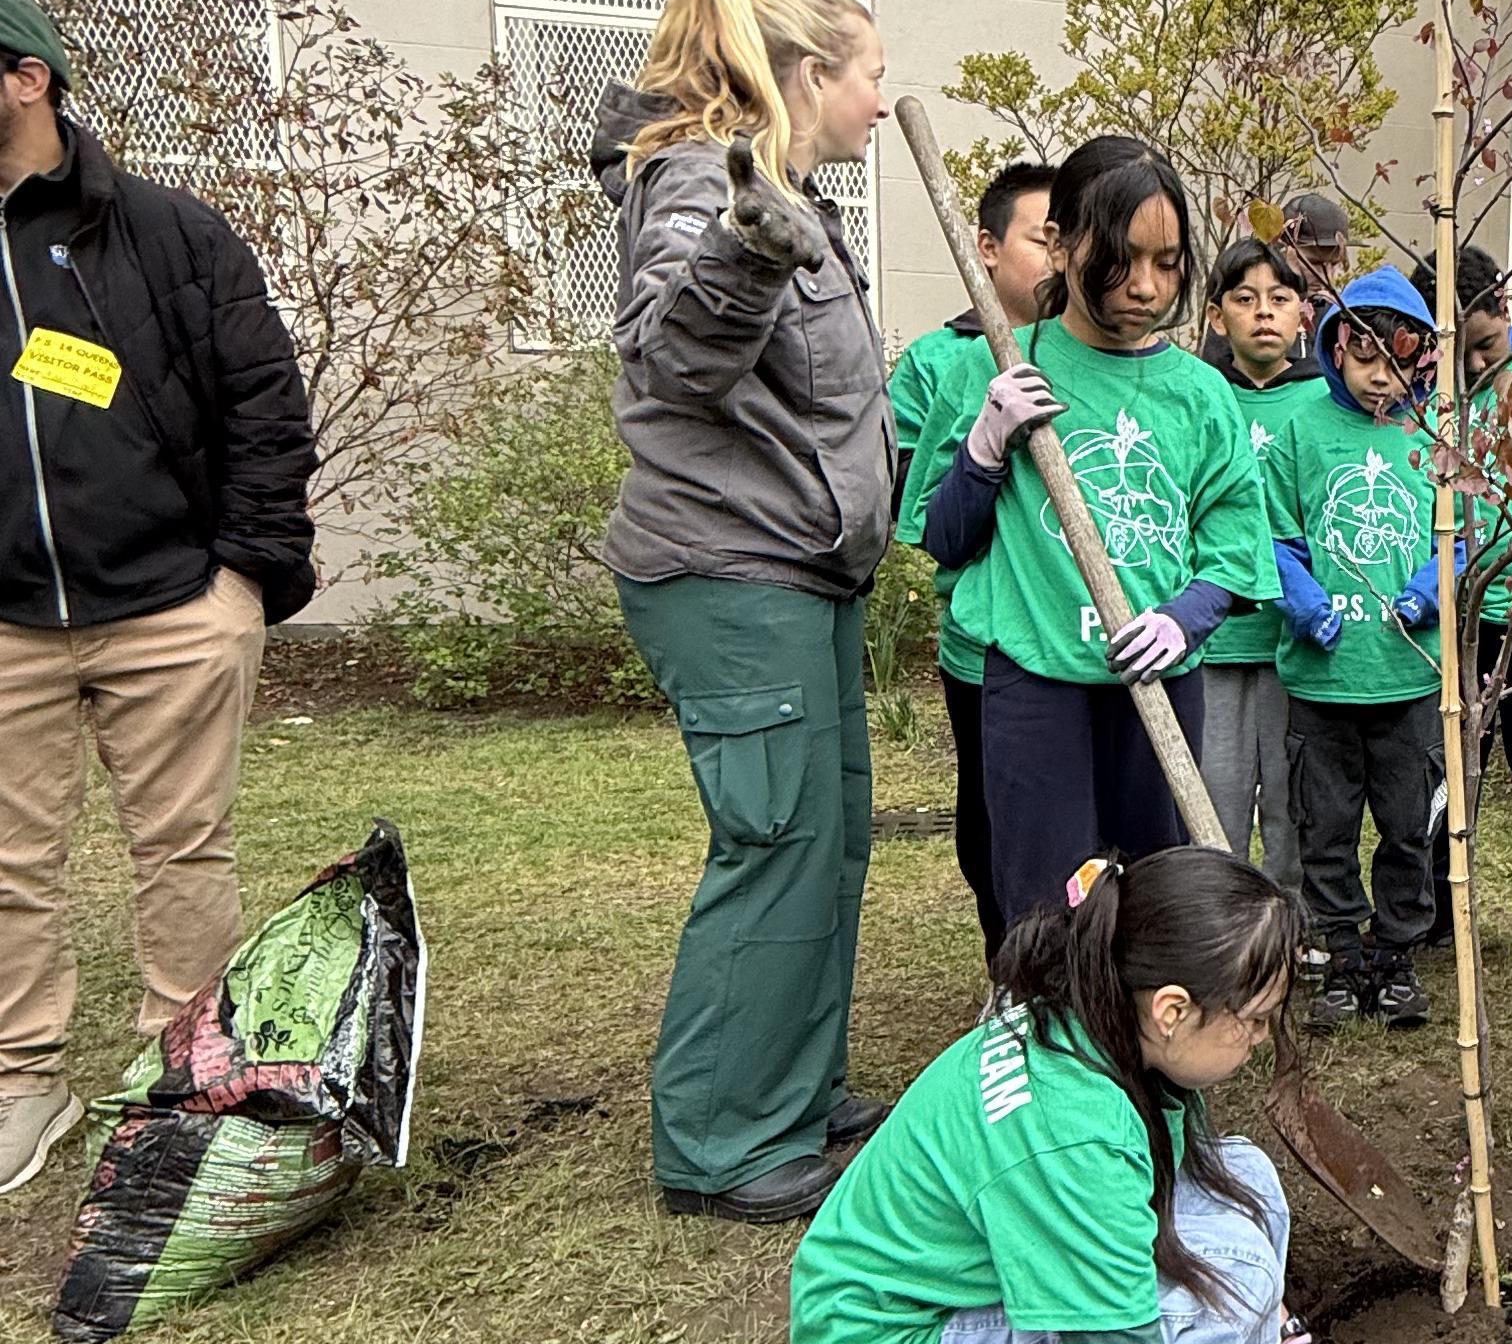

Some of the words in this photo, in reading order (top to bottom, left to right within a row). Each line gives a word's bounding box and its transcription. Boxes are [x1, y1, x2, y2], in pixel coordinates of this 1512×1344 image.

[28, 350, 80, 373] VISITOR
[83, 366, 113, 384] PASS
[1080, 606, 1108, 642] P.
[1332, 593, 1371, 622] P.S.
[979, 1022, 1033, 1125] TEAM
